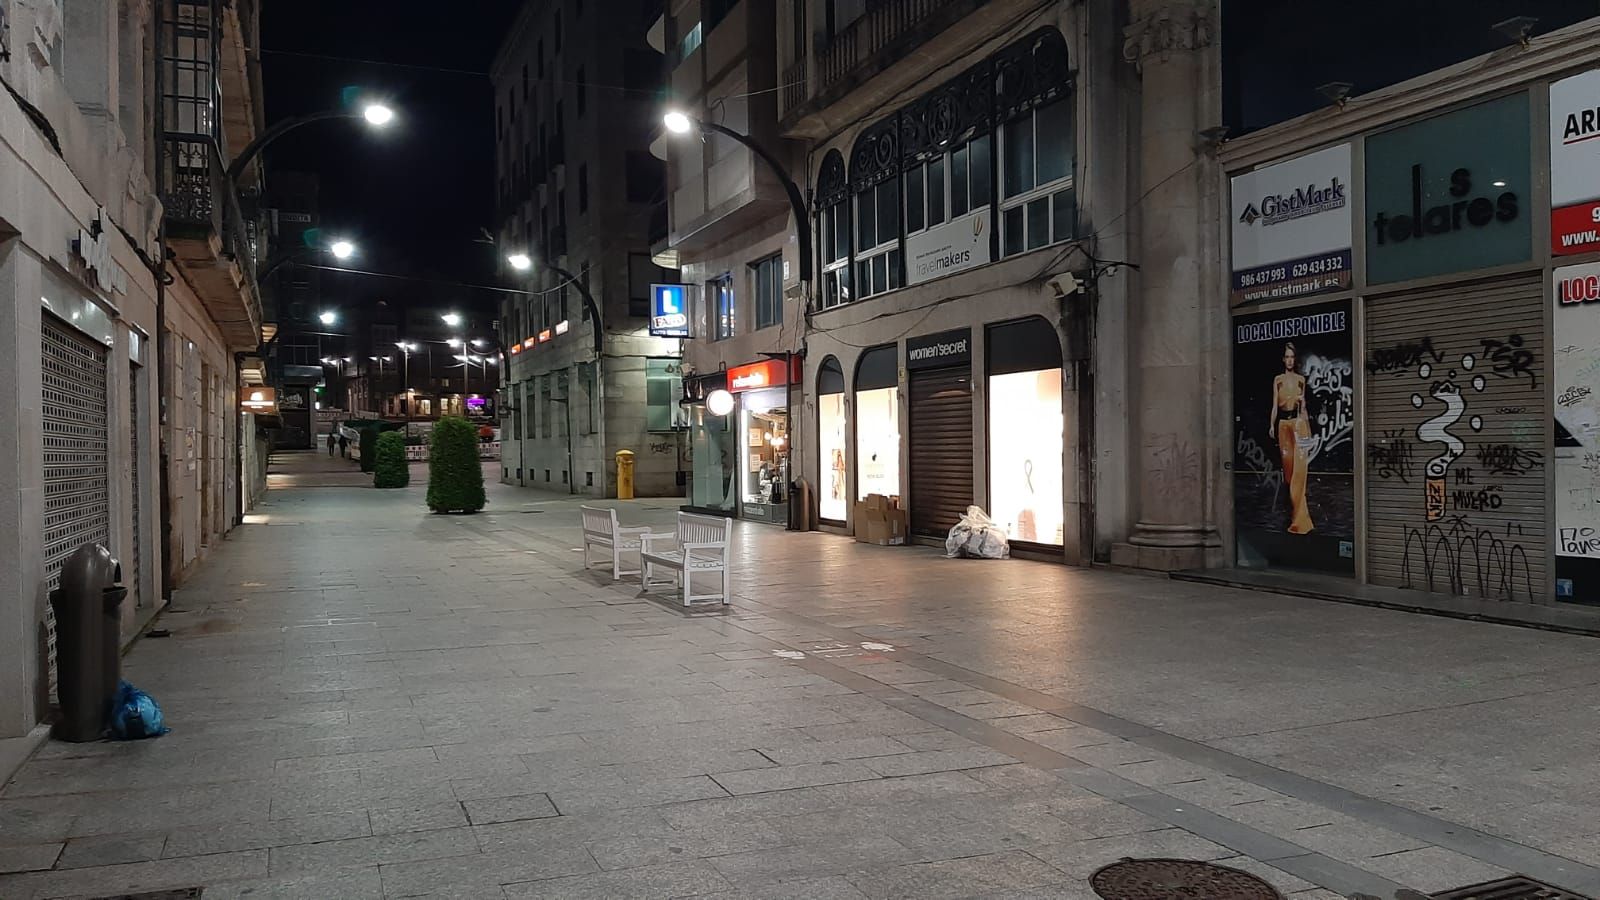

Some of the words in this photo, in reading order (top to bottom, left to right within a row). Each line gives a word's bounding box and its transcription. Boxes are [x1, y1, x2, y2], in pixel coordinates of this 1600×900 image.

[1261, 176, 1345, 217] GistMark
[1241, 274, 1255, 287] 986
[1256, 271, 1270, 284] 437
[1271, 267, 1286, 282] 993
[1292, 263, 1308, 277] 629
[1309, 260, 1325, 273] 434
[1327, 256, 1343, 270] 332
[663, 290, 678, 314] L
[1244, 278, 1339, 301] www.gistmarkes
[1561, 274, 1600, 304] LOC
[1237, 321, 1272, 344] LOCAL
[1272, 311, 1345, 339] DISPONIBLE
[909, 339, 967, 361] women'secret
[1455, 467, 1474, 485] ME
